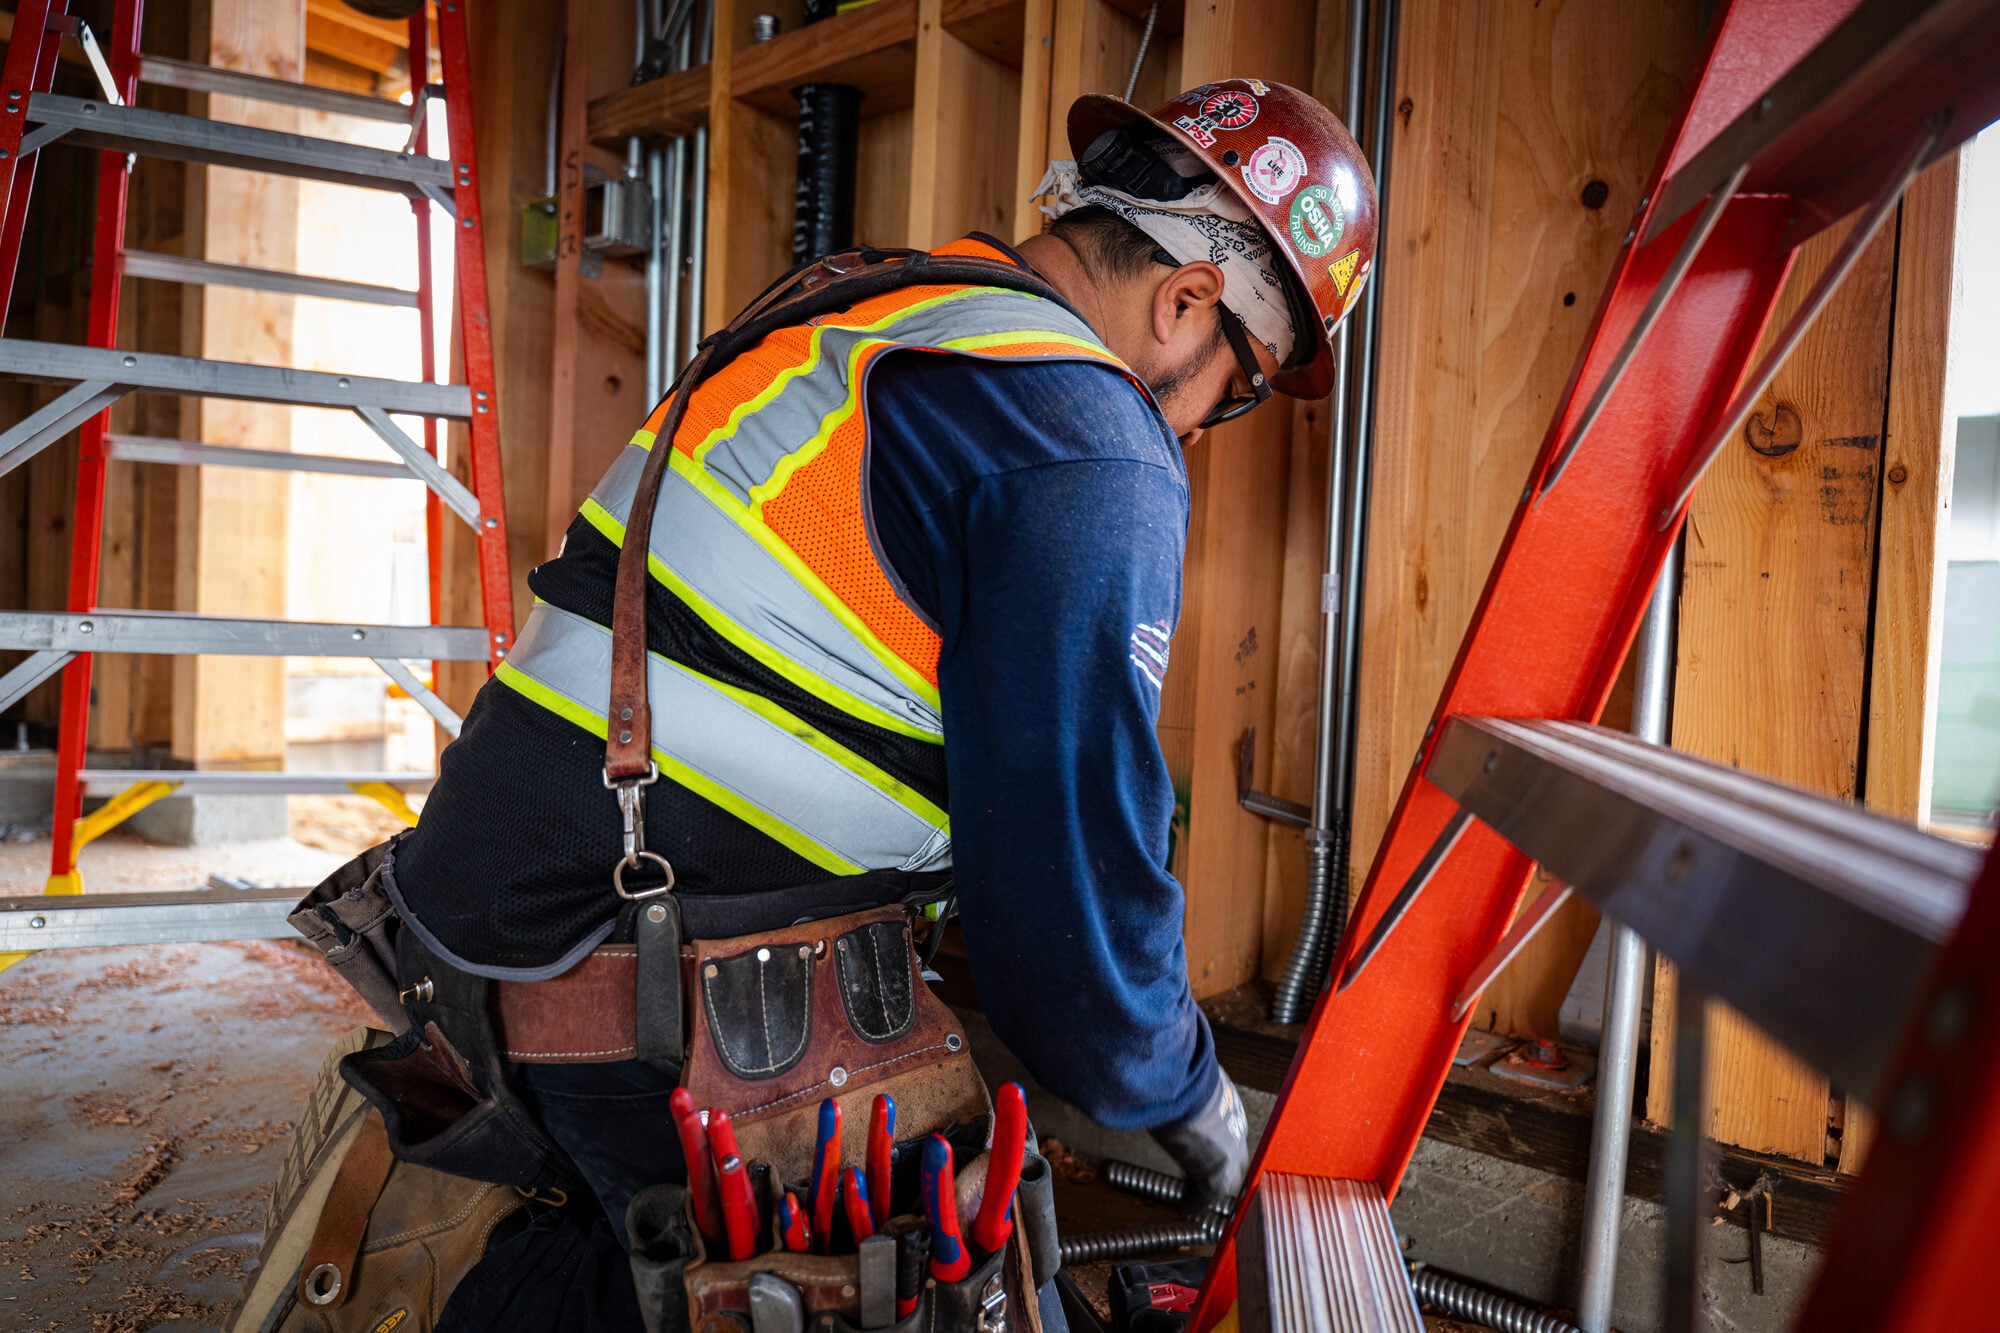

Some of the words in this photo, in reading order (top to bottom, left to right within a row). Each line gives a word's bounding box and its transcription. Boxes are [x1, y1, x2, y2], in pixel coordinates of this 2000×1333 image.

[1215, 101, 1241, 118] 30
[1267, 160, 1284, 177] LIFE
[1301, 196, 1335, 249] OSHA
[1315, 189, 1327, 200] 30
[1328, 195, 1344, 232] HOUR
[1291, 213, 1321, 255] TRAINED
[374, 1309, 406, 1333] KEE
